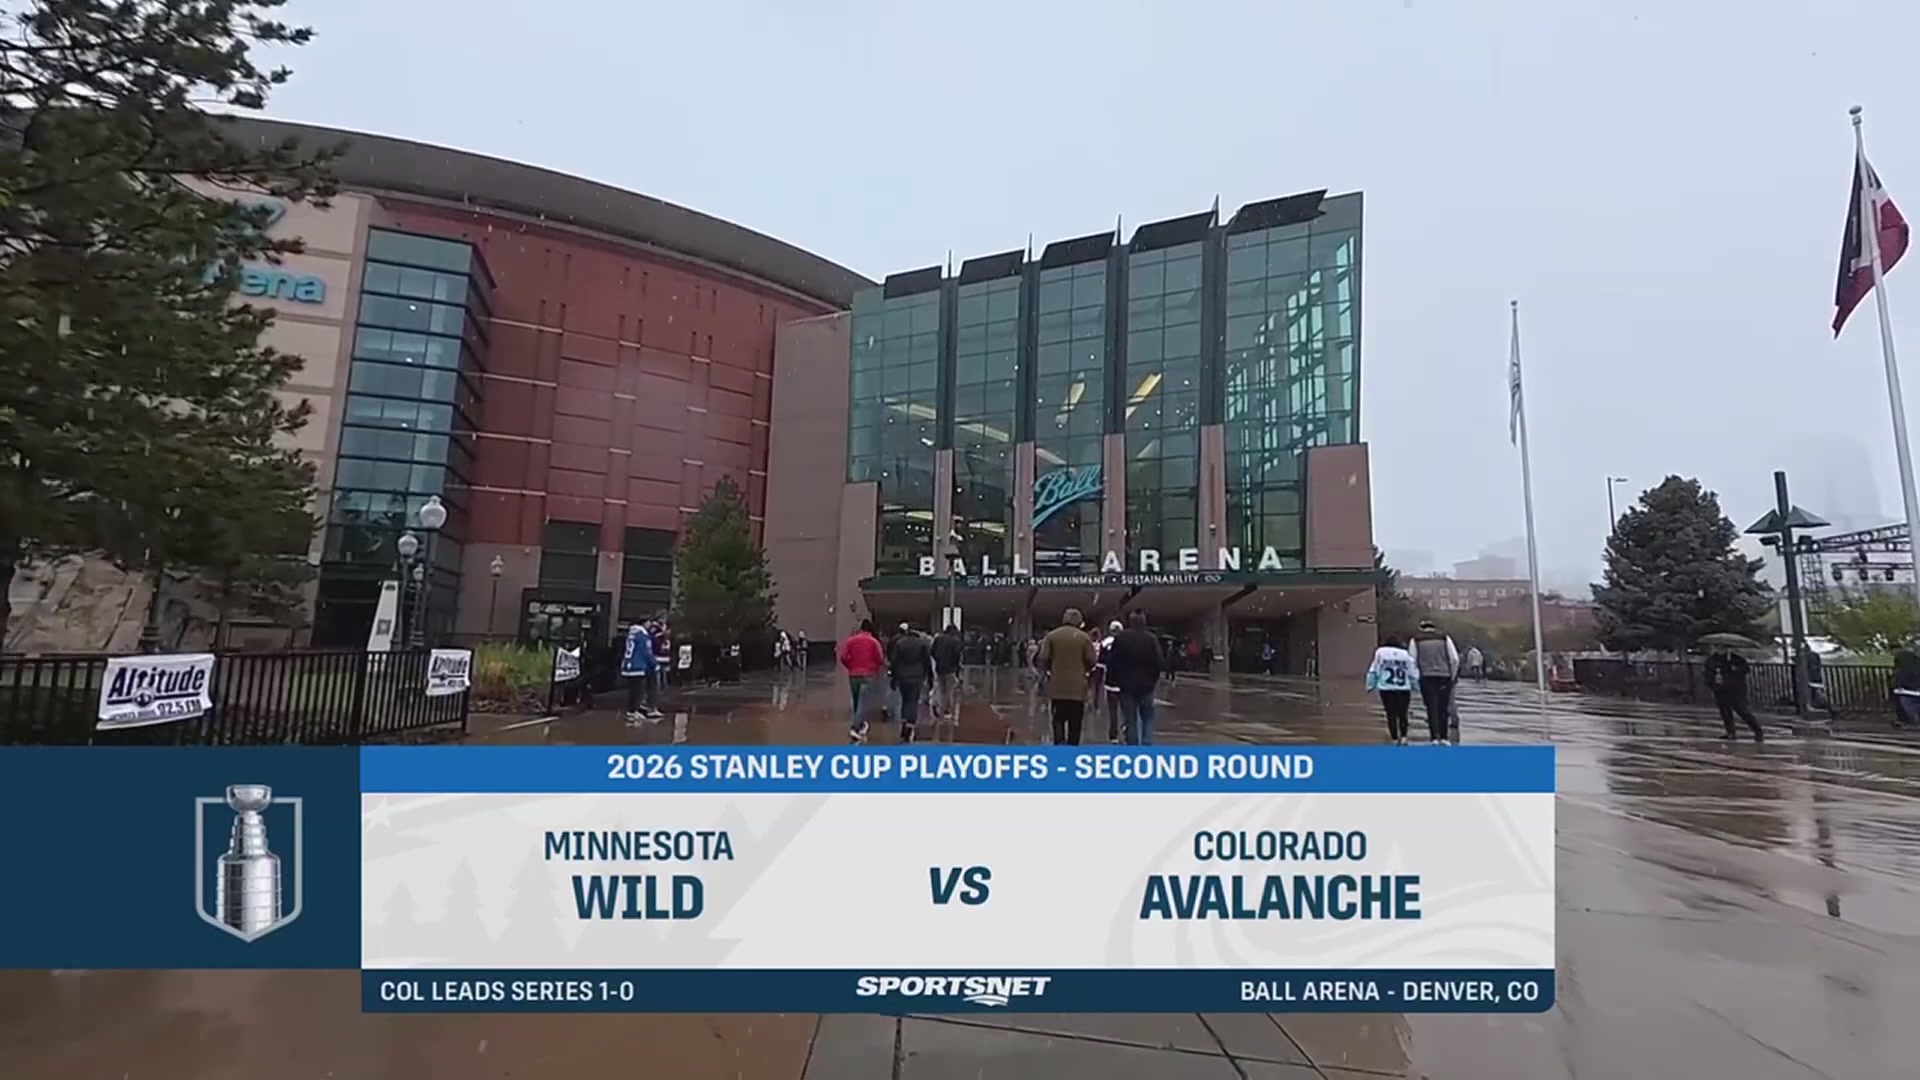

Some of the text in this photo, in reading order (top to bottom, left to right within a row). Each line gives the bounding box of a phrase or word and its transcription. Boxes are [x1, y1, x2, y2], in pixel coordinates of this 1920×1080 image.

[1033, 464, 1103, 515] Ball
[919, 546, 1283, 576] BALL ARENA
[984, 574, 1199, 586] SPORTS ENTERTAINMENT SUSTAINABILITY
[108, 665, 205, 698] Altitude
[1384, 667, 1406, 687] 29
